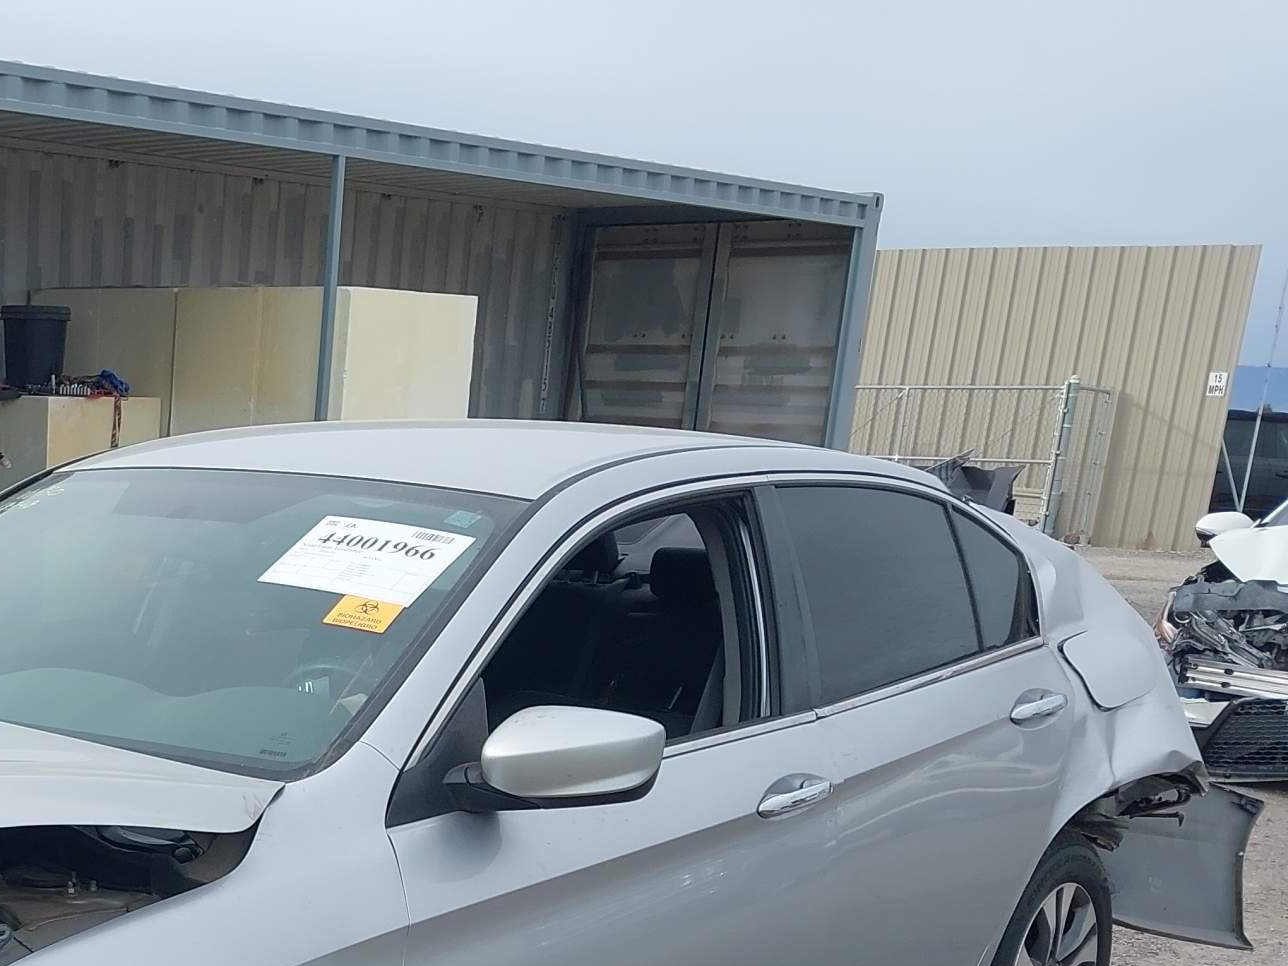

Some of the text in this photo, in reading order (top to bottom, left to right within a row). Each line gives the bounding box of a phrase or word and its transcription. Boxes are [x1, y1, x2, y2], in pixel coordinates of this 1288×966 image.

[1214, 373, 1223, 384] 15
[1208, 385, 1224, 394] MPH
[317, 532, 436, 561] 44001966
